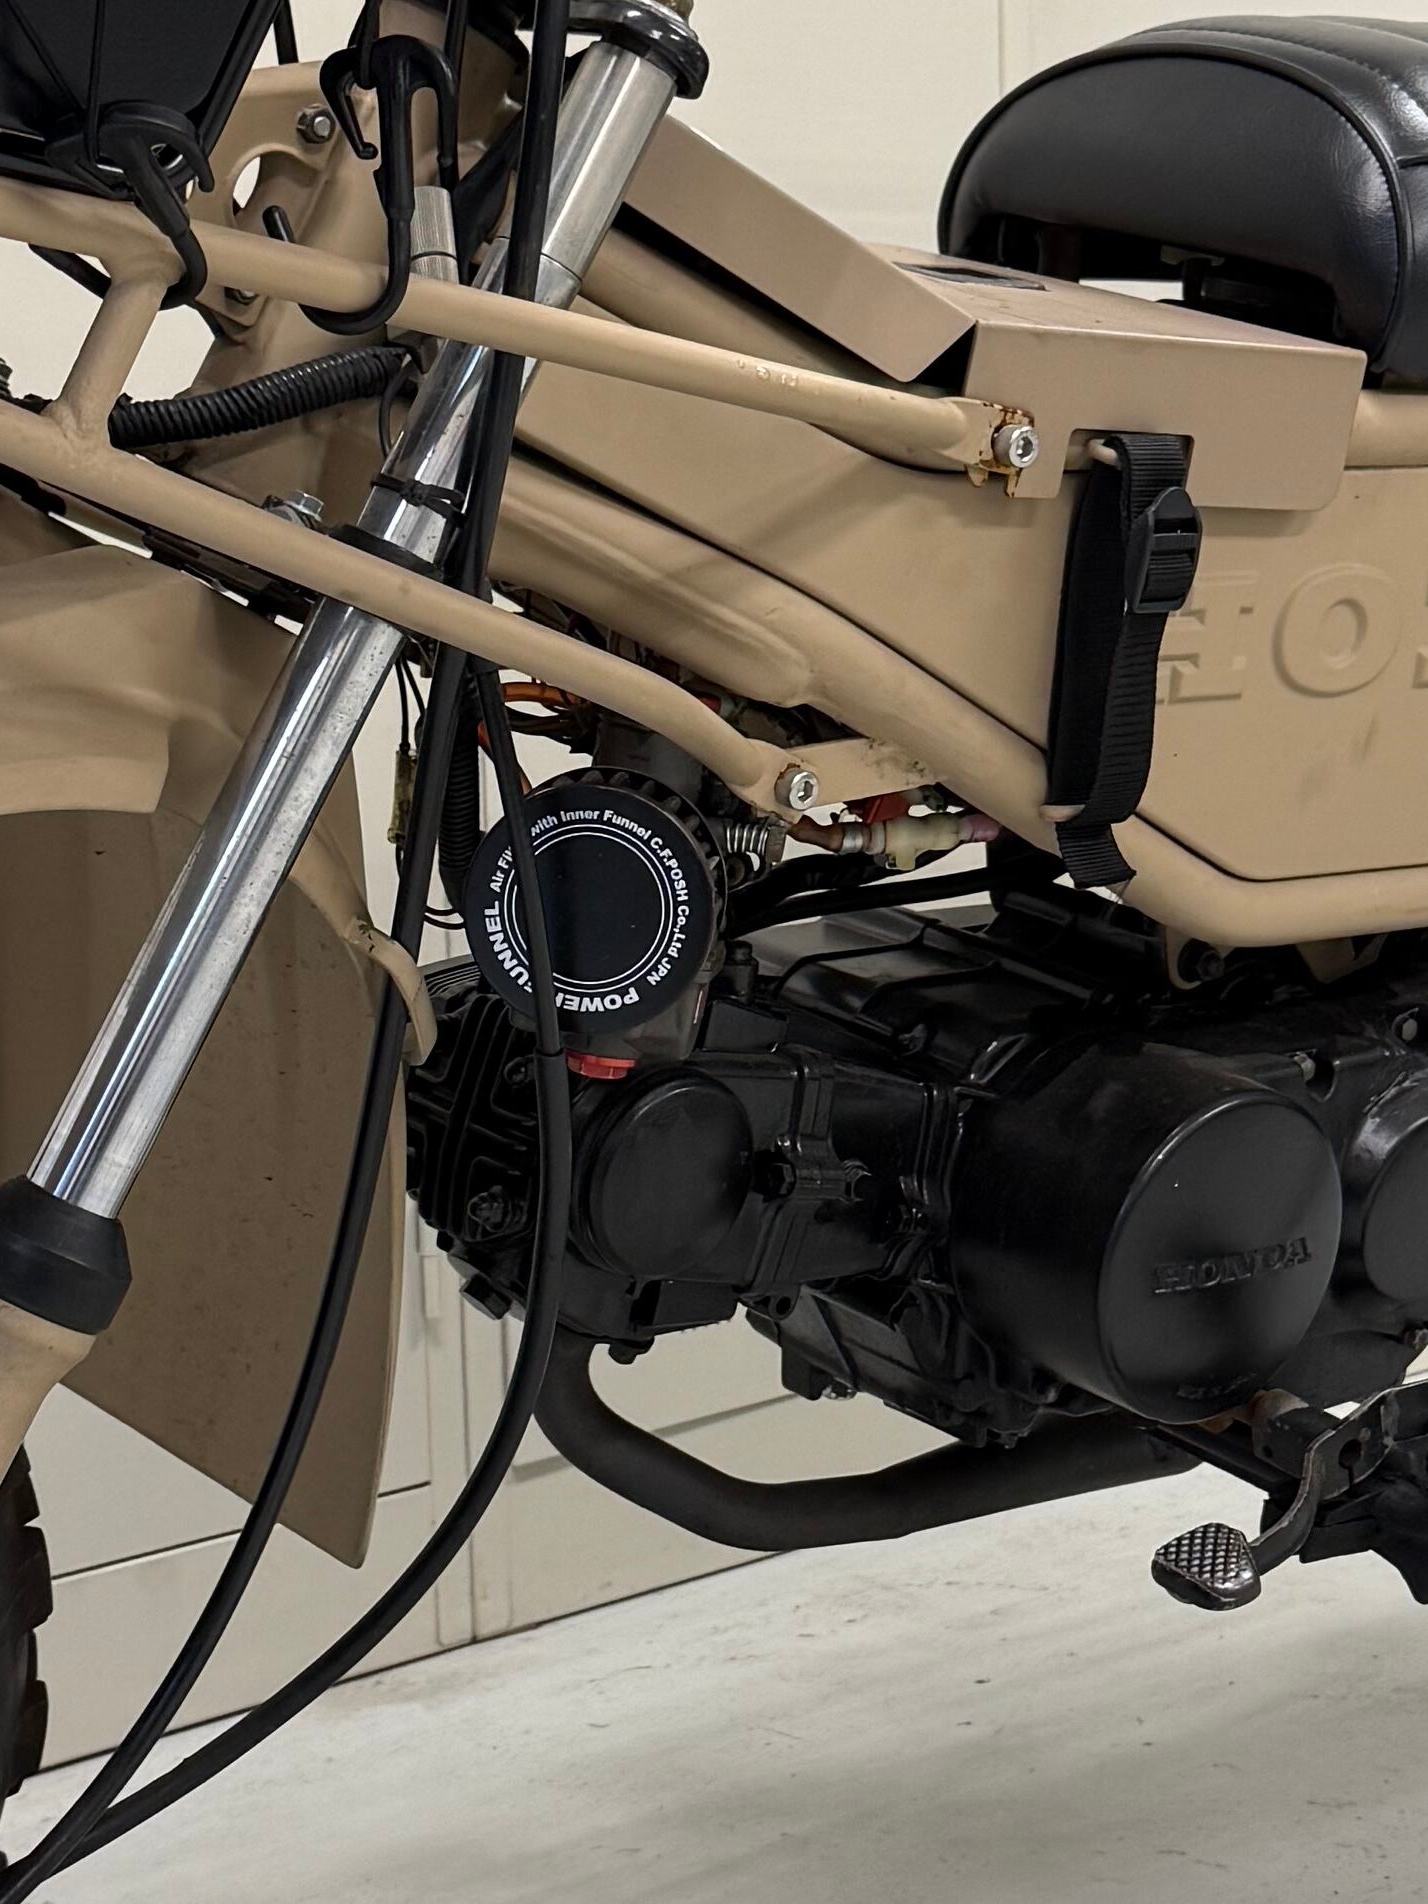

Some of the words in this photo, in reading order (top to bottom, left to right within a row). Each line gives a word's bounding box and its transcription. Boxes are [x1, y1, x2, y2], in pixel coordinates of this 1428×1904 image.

[560, 810, 600, 822] Inner
[603, 809, 652, 840] Funnel
[646, 957, 671, 986] JPN
[484, 900, 533, 993] UNNEL
[1153, 1236, 1312, 1295] HONDA
